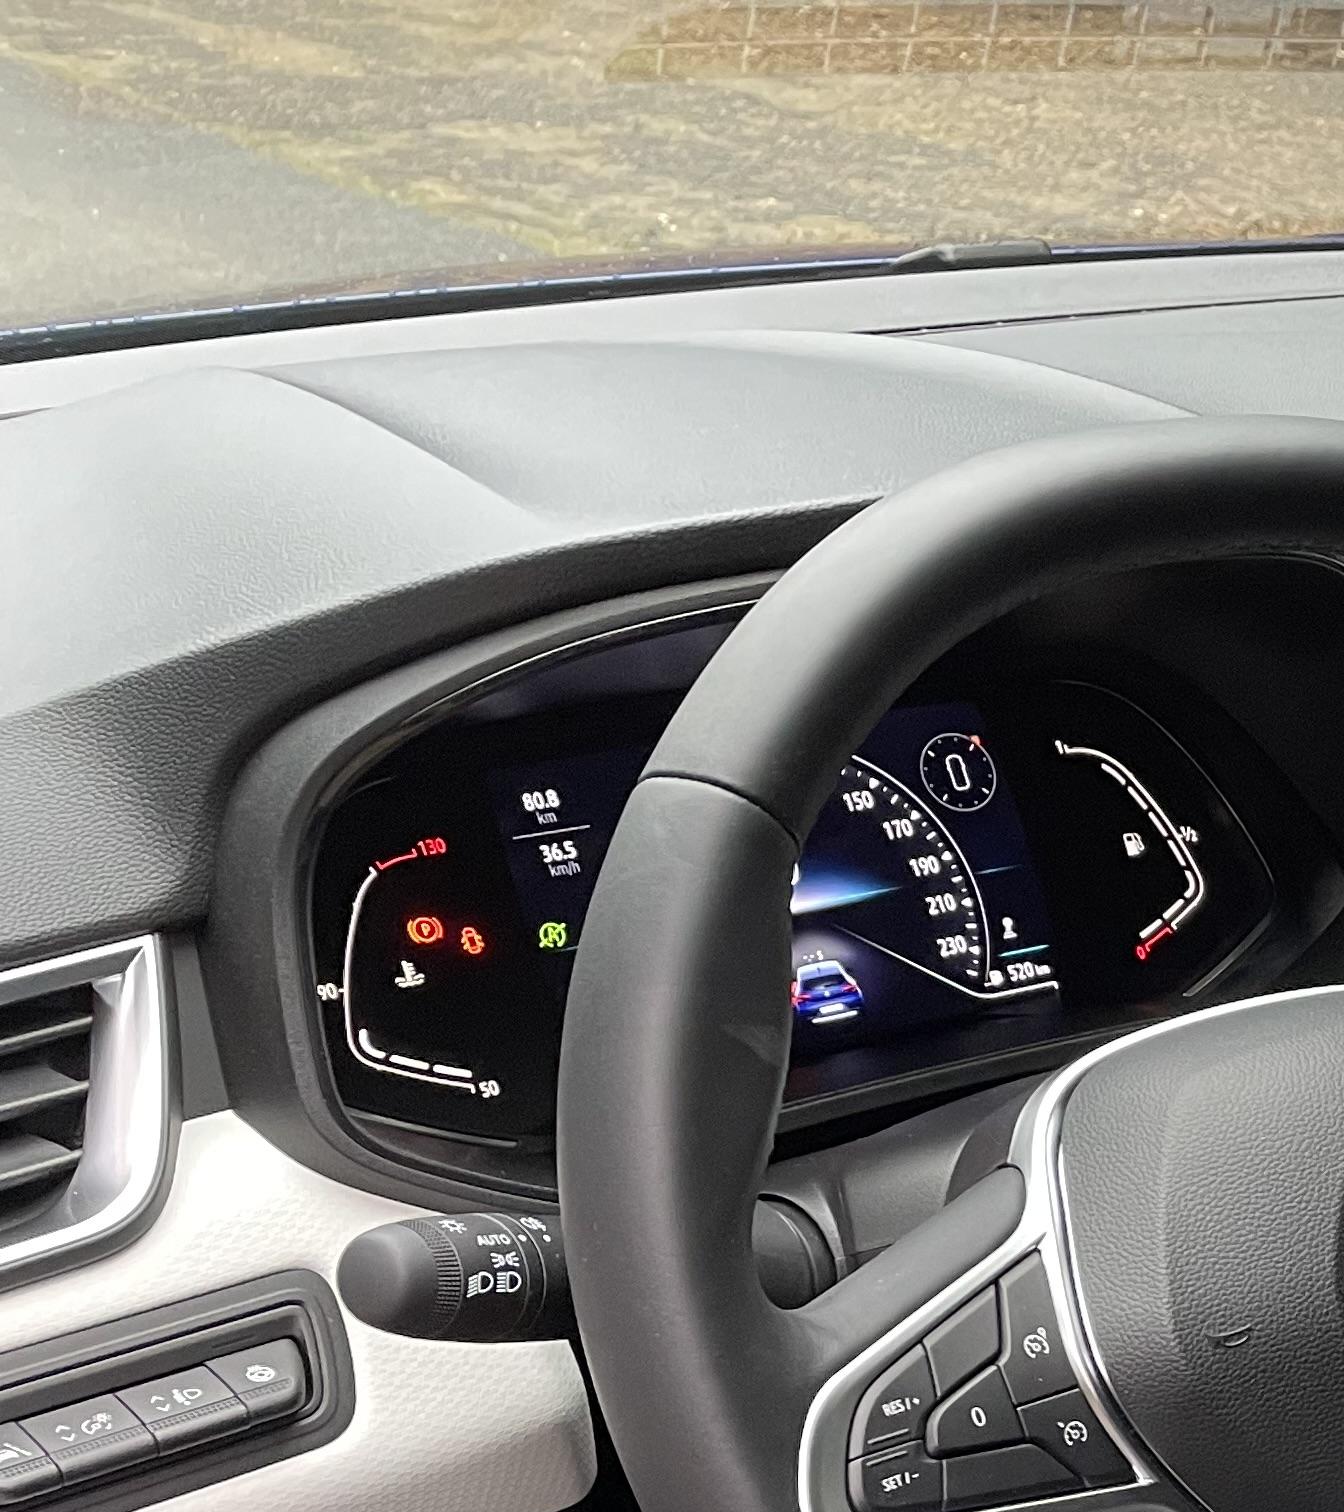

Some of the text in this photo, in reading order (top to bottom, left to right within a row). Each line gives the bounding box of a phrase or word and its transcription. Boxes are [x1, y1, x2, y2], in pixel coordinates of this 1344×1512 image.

[521, 788, 561, 812] 80.8
[842, 790, 875, 812] 150
[535, 811, 558, 825] km
[882, 818, 914, 841] 170
[416, 837, 447, 857] 130
[538, 840, 578, 864] 36.5
[547, 861, 582, 878] km/h
[909, 854, 941, 878] 190
[925, 892, 957, 916] 210
[936, 934, 968, 959] 230
[1006, 960, 1035, 983] 520
[316, 982, 339, 1001] 90
[479, 1079, 501, 1099] 50
[476, 1233, 511, 1246] AUTO
